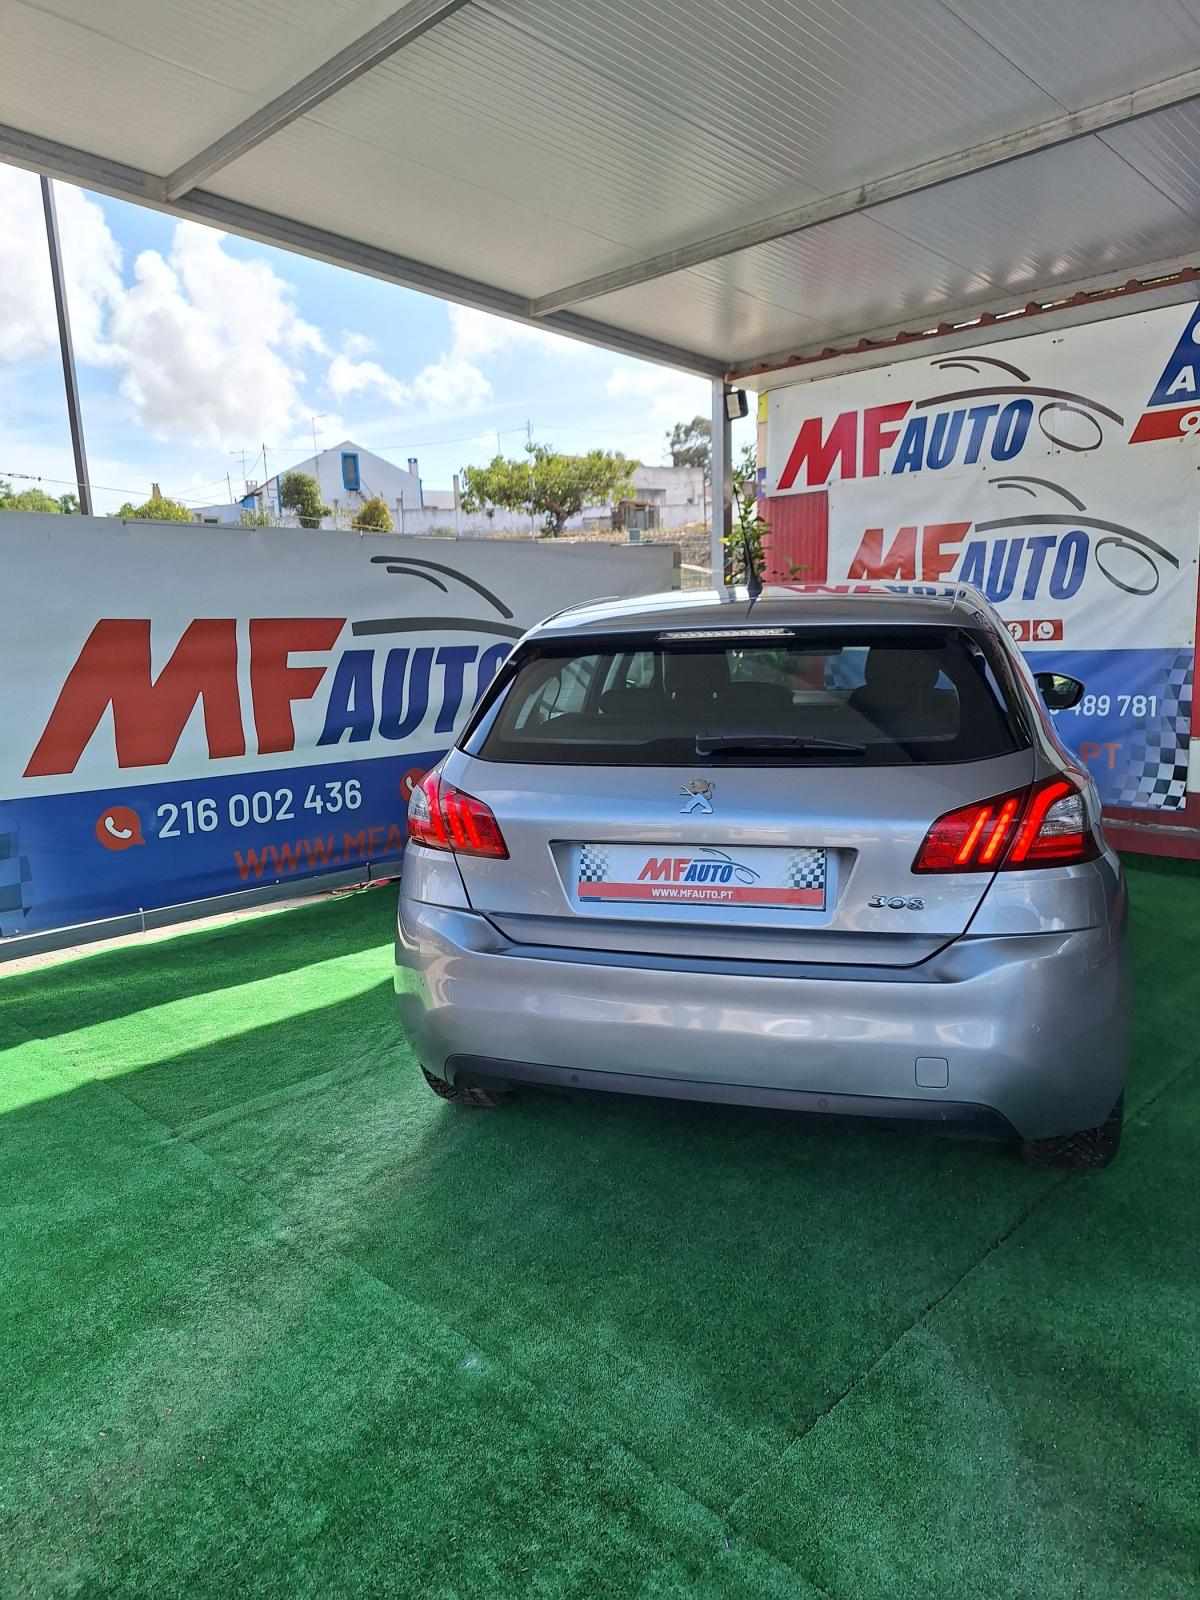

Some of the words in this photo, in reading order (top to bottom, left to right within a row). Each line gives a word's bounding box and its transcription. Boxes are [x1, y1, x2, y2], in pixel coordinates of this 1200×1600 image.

[1074, 694, 1110, 717] 89
[1117, 694, 1157, 718] 781
[157, 798, 218, 839] 216
[229, 788, 295, 828] 002
[304, 779, 362, 815] 436
[651, 887, 734, 899] WWW.MFAUTO.PT
[867, 894, 925, 911] 308
